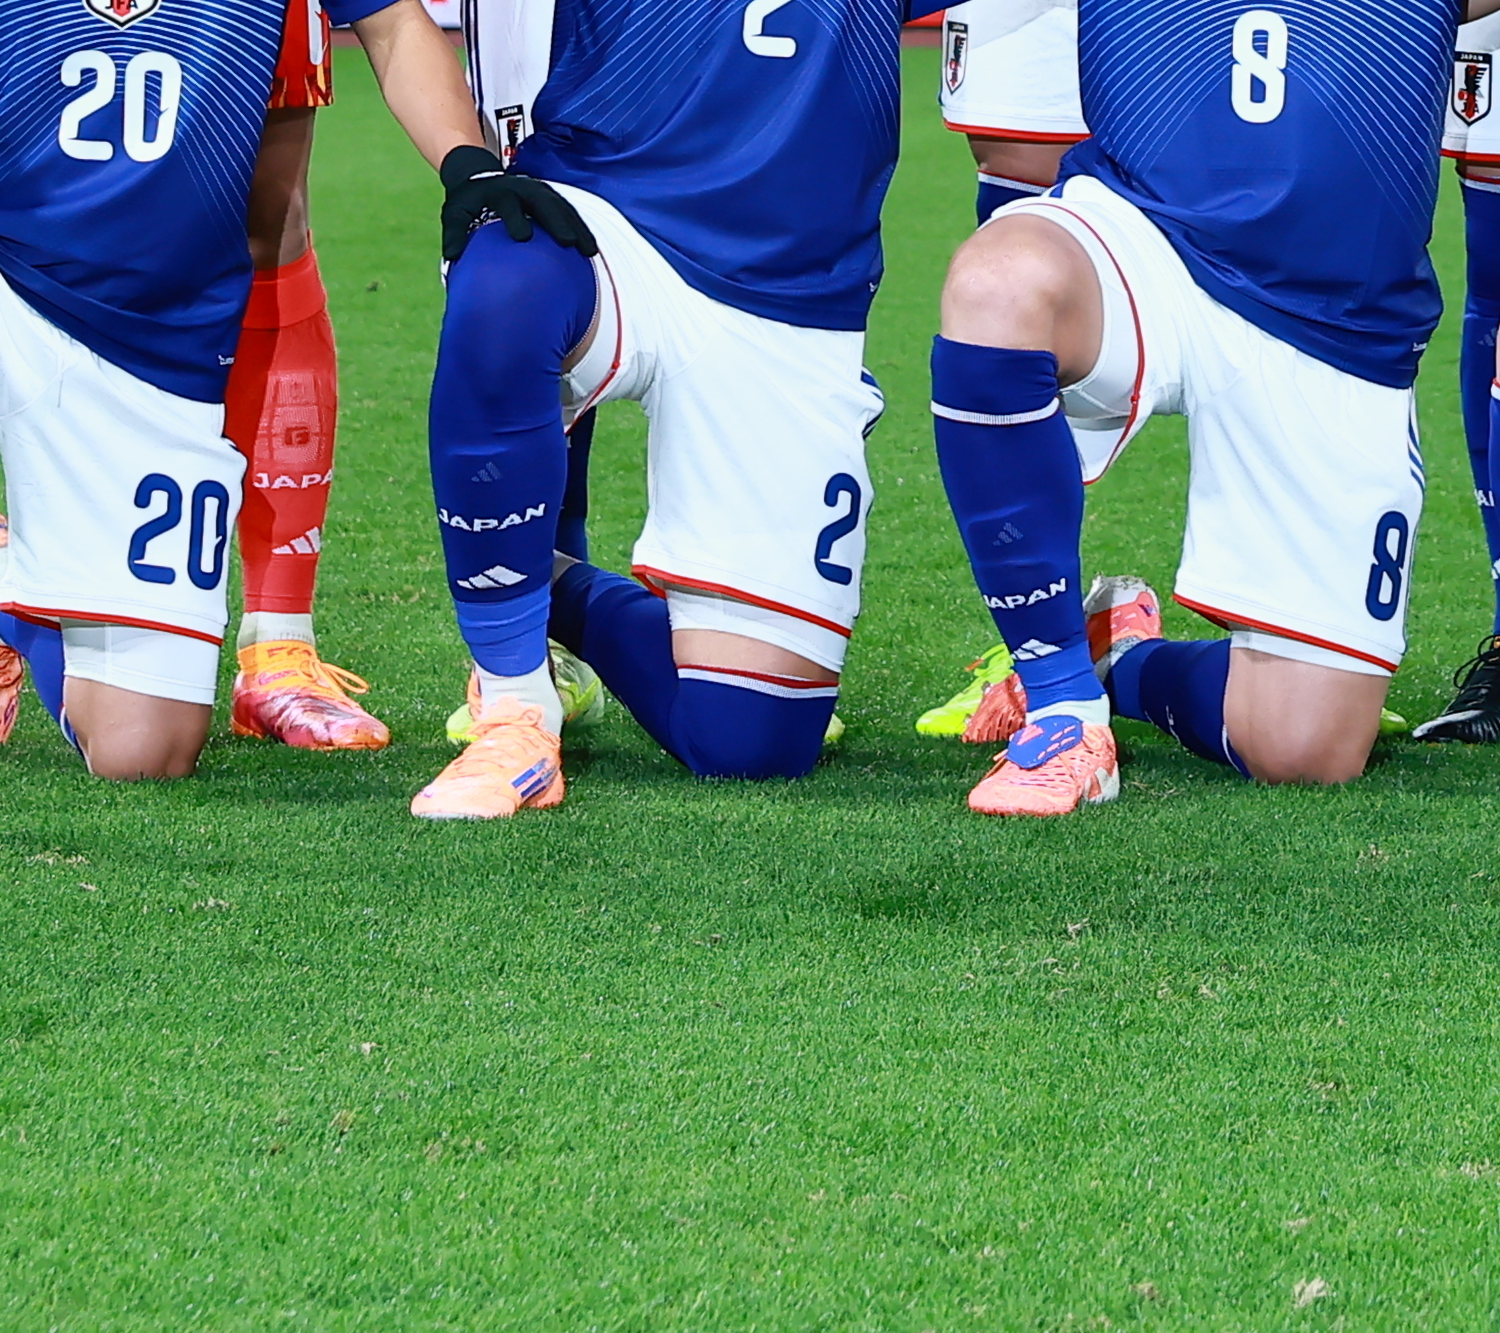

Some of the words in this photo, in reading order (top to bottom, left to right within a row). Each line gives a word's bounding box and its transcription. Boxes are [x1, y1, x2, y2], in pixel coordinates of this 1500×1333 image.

[58, 49, 182, 162] 20
[1230, 9, 1288, 123] 8
[128, 473, 230, 590] 20
[814, 472, 861, 585] 2
[1365, 510, 1409, 621] 8
